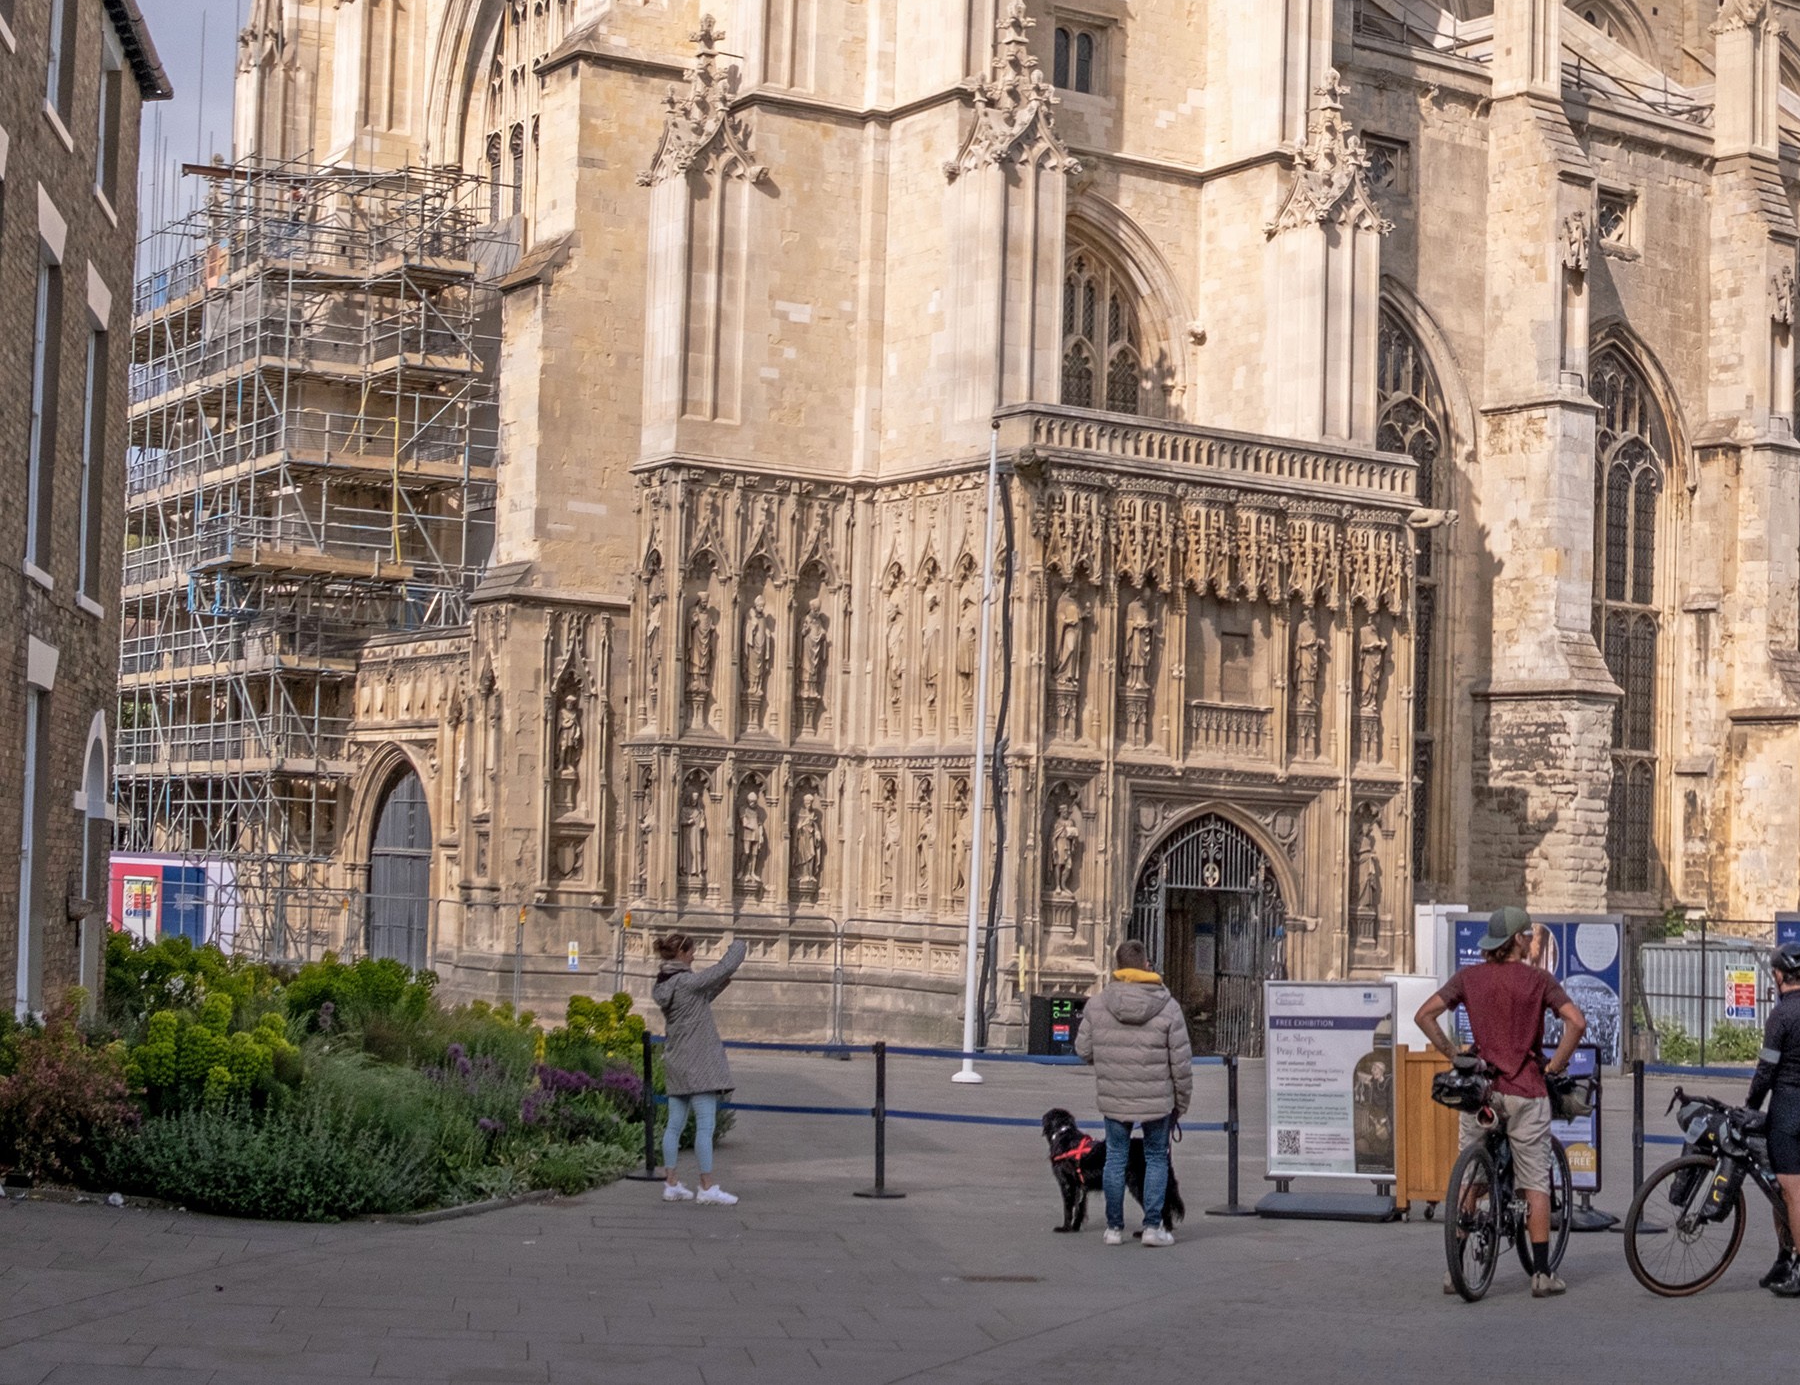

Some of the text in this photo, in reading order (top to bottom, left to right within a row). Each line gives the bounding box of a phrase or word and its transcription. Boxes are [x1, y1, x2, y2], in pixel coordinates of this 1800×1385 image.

[1275, 1019, 1334, 1027] FREE EXHIBITION
[1276, 1033, 1315, 1045] Eat. Sleep.
[1276, 1047, 1325, 1059] Pray. Repeat.
